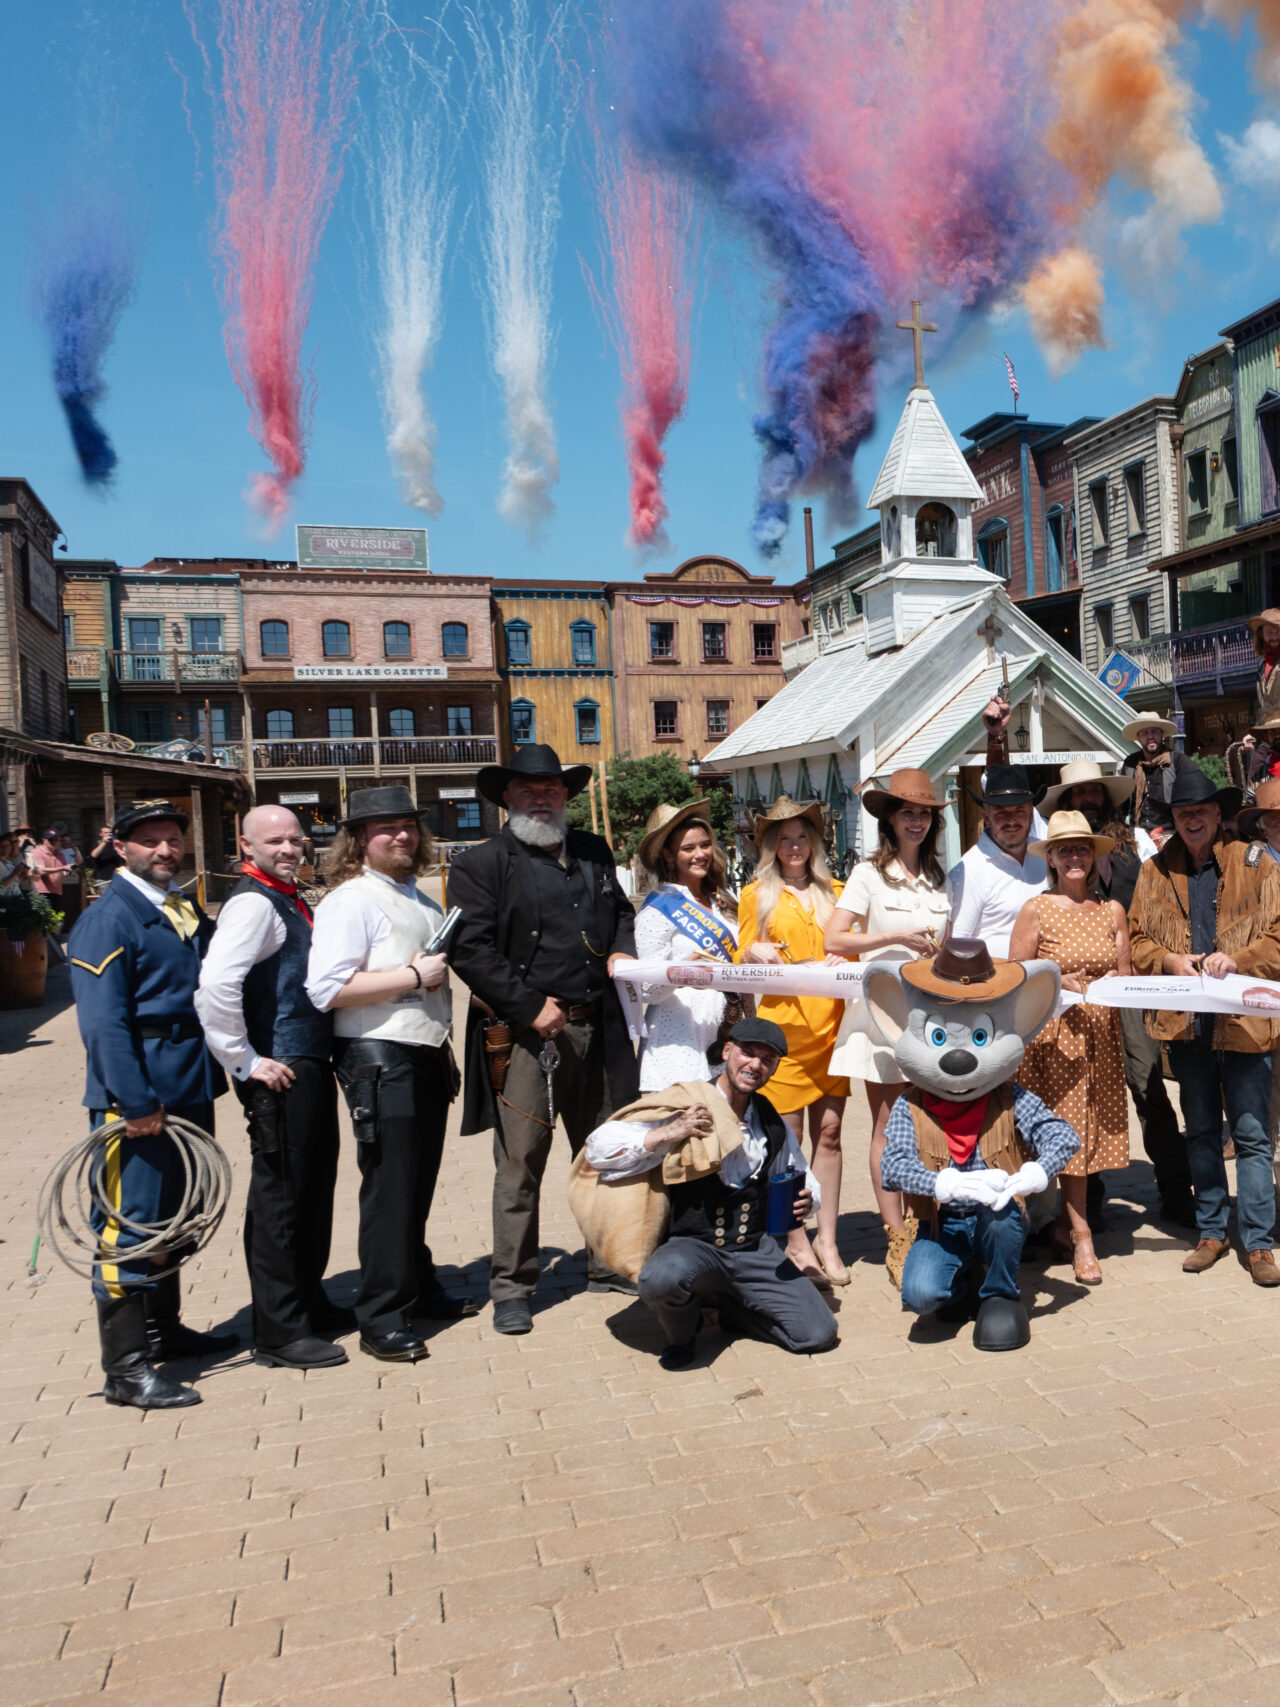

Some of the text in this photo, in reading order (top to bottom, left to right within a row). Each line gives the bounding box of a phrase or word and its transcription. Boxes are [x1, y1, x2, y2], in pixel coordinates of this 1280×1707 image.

[326, 538, 400, 555] RIVERSIDE
[297, 668, 445, 676] SILVER LAKE GAZETTE.
[1020, 753, 1037, 764] SAN
[1043, 753, 1081, 763] ANTONIO
[681, 902, 724, 939] EUROPA
[671, 910, 718, 952] FACE OF
[721, 967, 784, 977] RIVERSIDE
[836, 972, 863, 981] EURO
